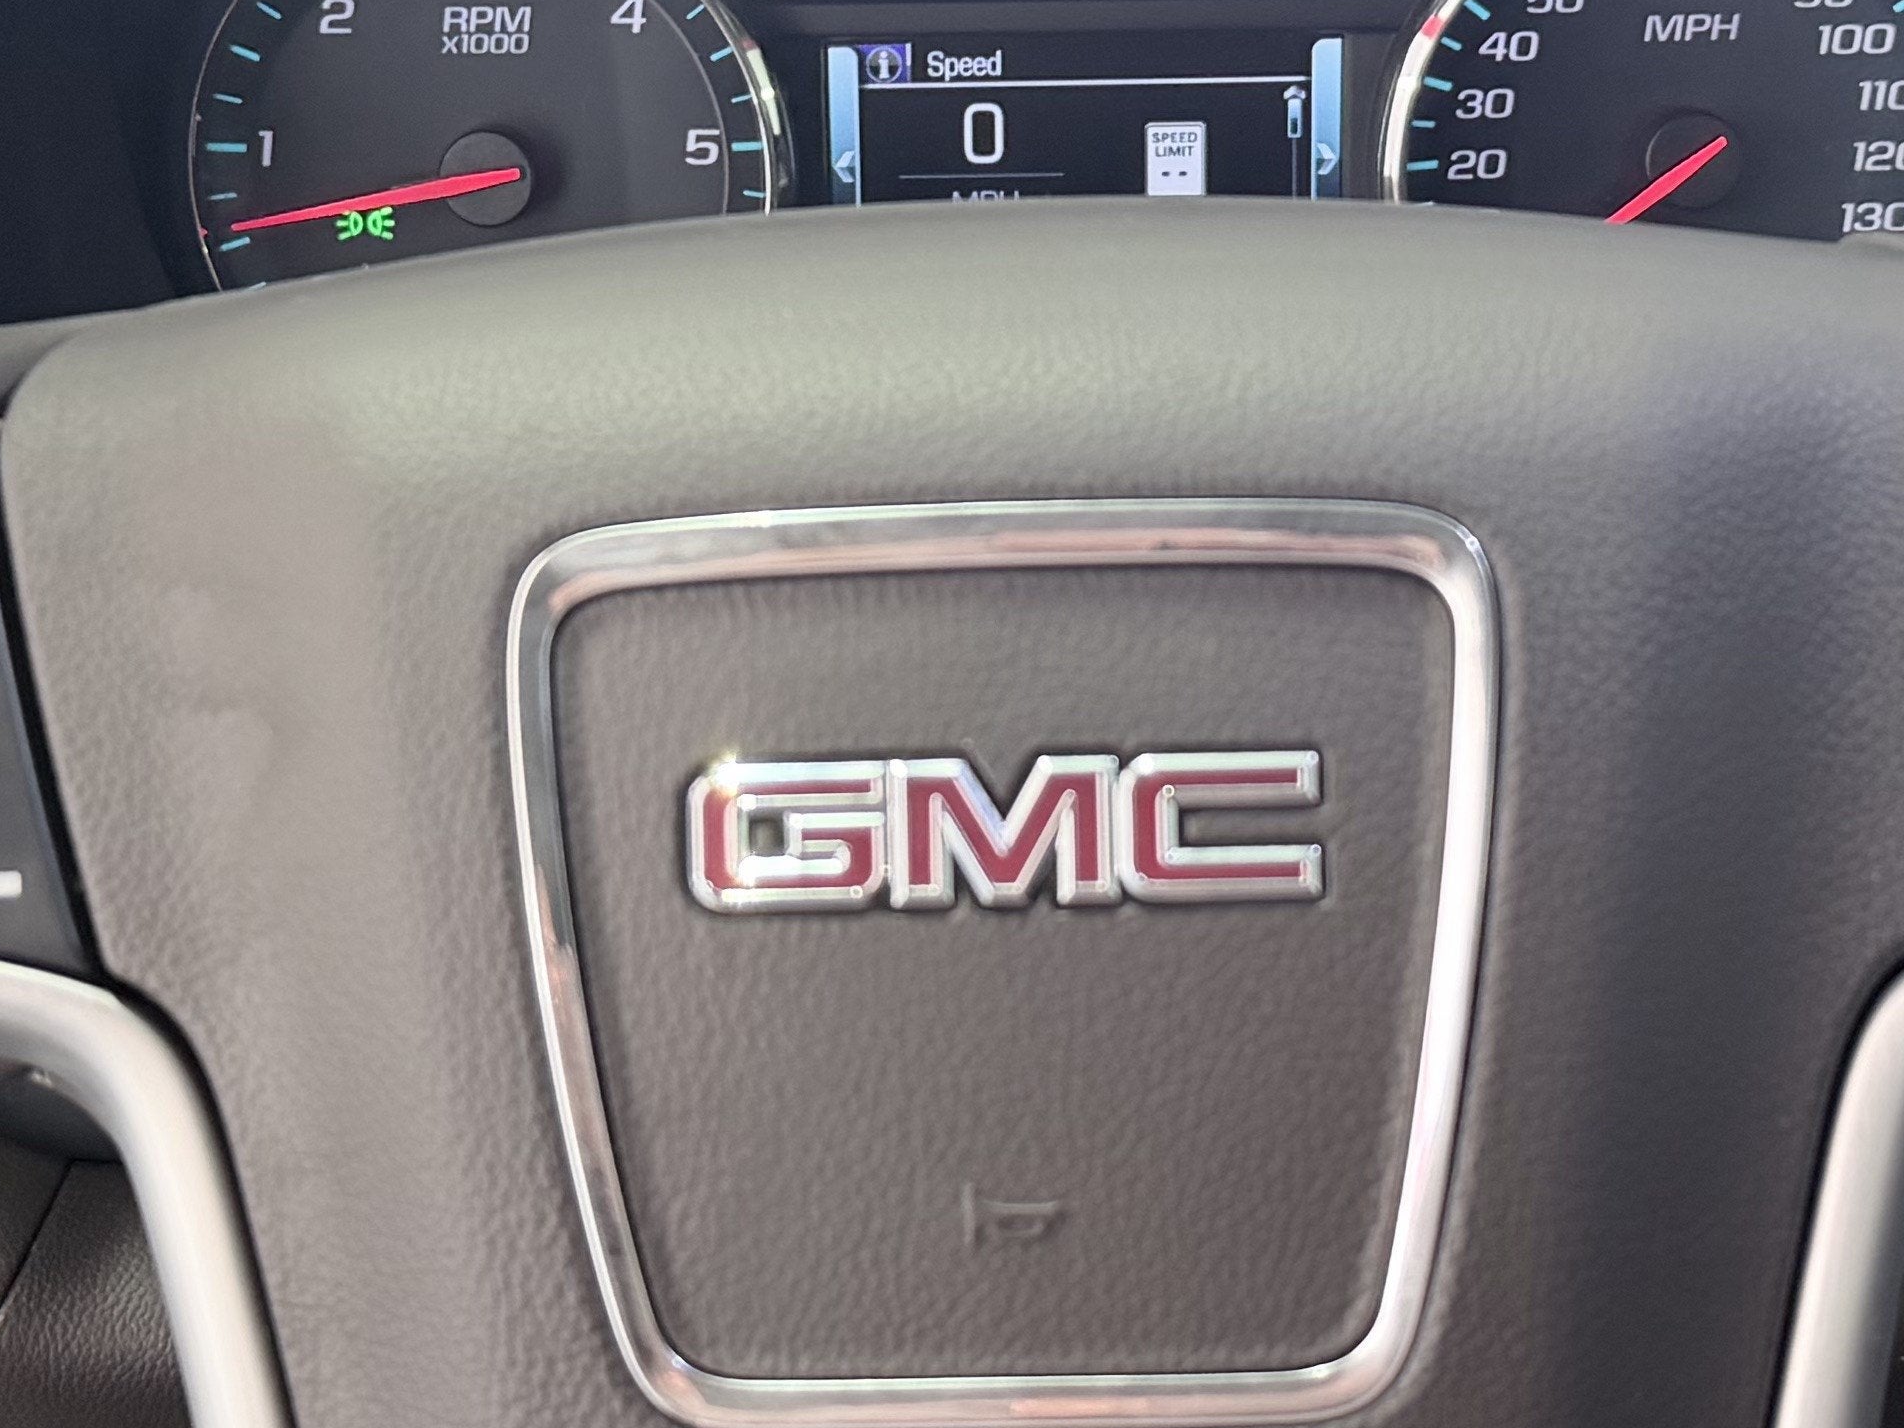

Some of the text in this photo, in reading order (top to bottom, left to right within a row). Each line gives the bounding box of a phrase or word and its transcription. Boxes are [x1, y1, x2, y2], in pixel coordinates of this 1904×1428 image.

[442, 6, 533, 33] RPM
[1644, 13, 1741, 42] MPH
[1478, 30, 1540, 62] 40
[1818, 23, 1896, 55] 100
[927, 49, 1004, 81] Speed
[1456, 87, 1515, 120] 30
[258, 130, 273, 167] 1
[685, 128, 721, 166] 5
[963, 102, 1004, 165] 0
[1152, 132, 1197, 143] SPEED
[1155, 146, 1194, 157] LIMIT
[1447, 149, 1507, 180] 20
[688, 750, 1324, 912] GMC
